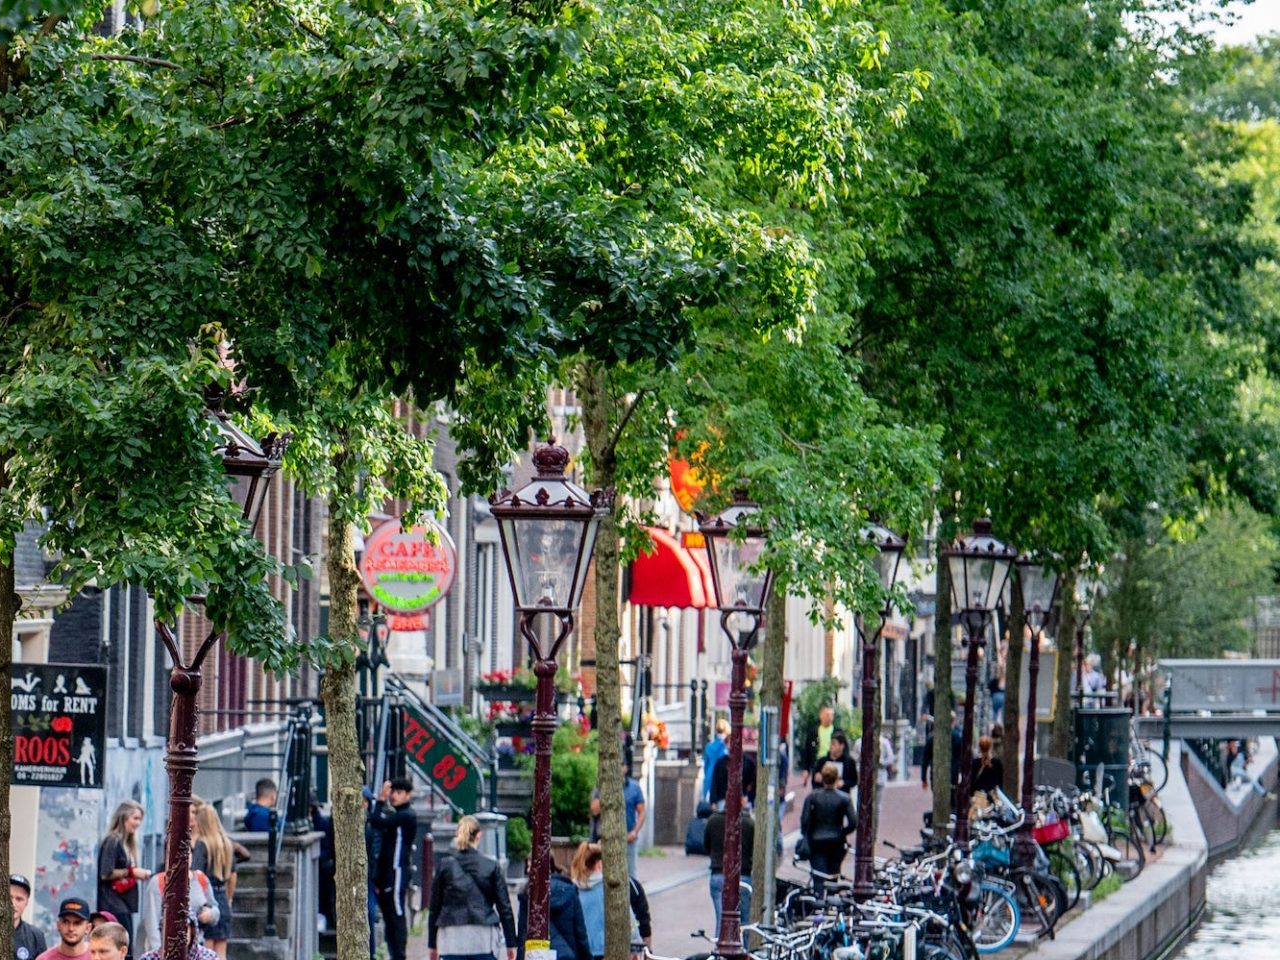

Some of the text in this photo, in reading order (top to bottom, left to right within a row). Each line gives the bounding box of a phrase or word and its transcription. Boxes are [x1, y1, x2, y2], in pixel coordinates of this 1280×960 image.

[11, 694, 98, 714] OMS for RENT
[14, 735, 71, 765] ROOS
[403, 711, 467, 790] TEL 83
